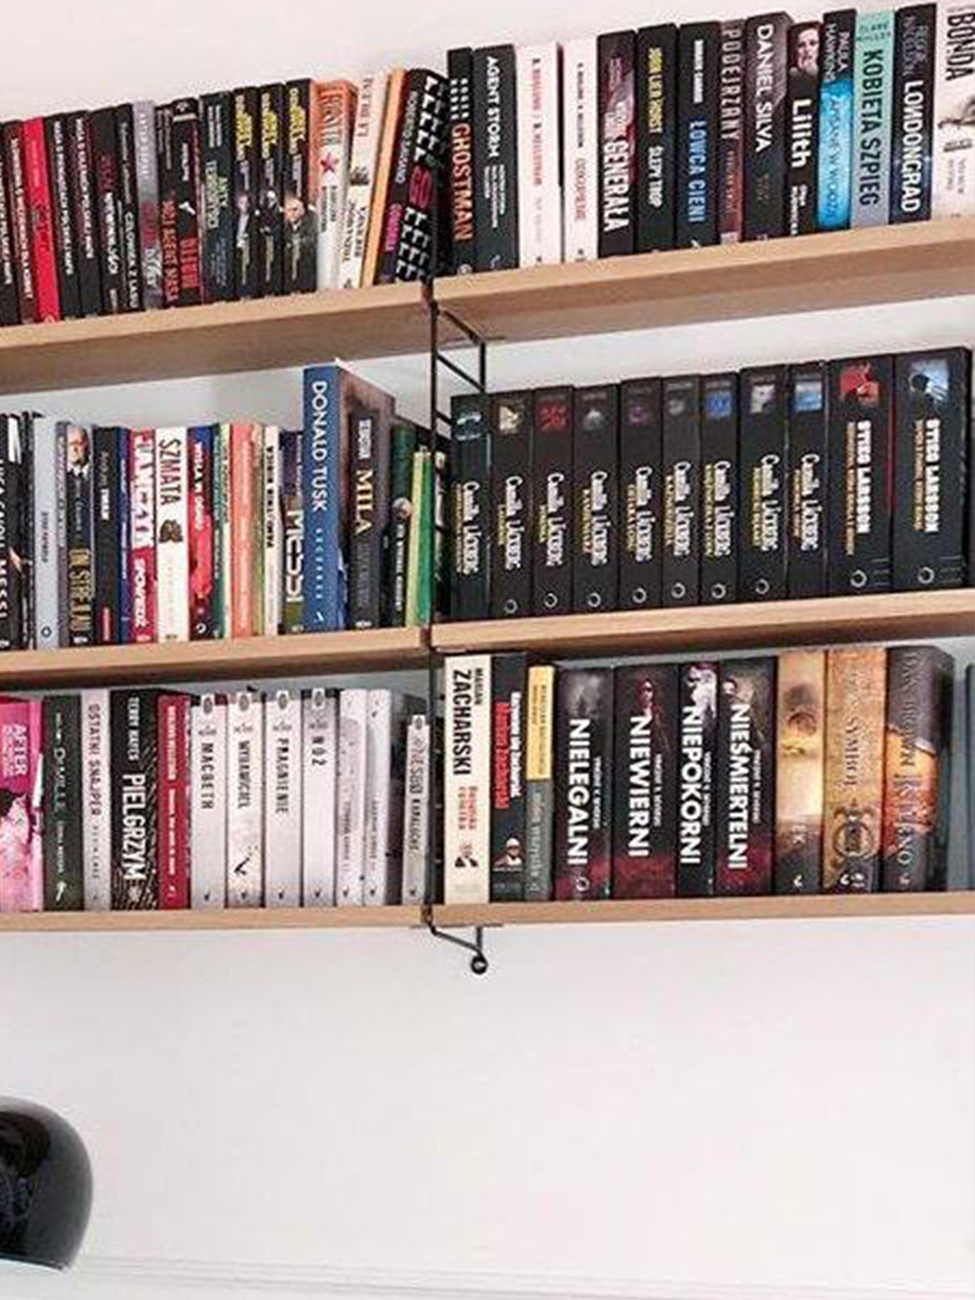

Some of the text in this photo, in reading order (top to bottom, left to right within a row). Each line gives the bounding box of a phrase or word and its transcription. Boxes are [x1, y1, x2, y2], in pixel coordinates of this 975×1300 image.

[720, 29, 741, 140] PODEJRZANY
[756, 24, 773, 152] DANIEL SILVA
[838, 32, 848, 71] PAULA
[946, 14, 975, 80] BONDA
[486, 56, 500, 157] AGENT STORM
[792, 98, 811, 168] Lilith
[859, 50, 883, 205] KOBIETA SZPIEG
[452, 123, 473, 240] GHOSTMAN
[603, 141, 629, 231] GENERAŁA
[648, 181, 663, 208] TROP
[688, 121, 707, 222] ŁOWCA CIENI
[128, 279, 138, 308] LASU
[312, 381, 327, 461] DONALD
[159, 439, 182, 505] SZMATA
[313, 462, 327, 512] TUSK
[355, 469, 374, 535] MILA
[857, 420, 870, 534] STIEG LARSSON
[925, 419, 940, 532] STIEG LARSSON
[900, 652, 918, 688] DAN
[11, 724, 28, 775] AFTER
[89, 704, 102, 816] OSTATNI SNAJPER
[453, 669, 472, 775] ZACHARSKI
[844, 718, 859, 787] SYMBOL
[899, 696, 920, 766] BROWN
[201, 743, 214, 809] MACBETH
[276, 738, 289, 814] PRAGNIENIE
[567, 719, 590, 865] NIELEGALNI
[627, 715, 650, 857] NIEWIERNI
[680, 705, 702, 864] NIEPOKORNI
[727, 703, 752, 869] NIEŚMIERTELNI
[122, 773, 146, 879] PIELGRZYM
